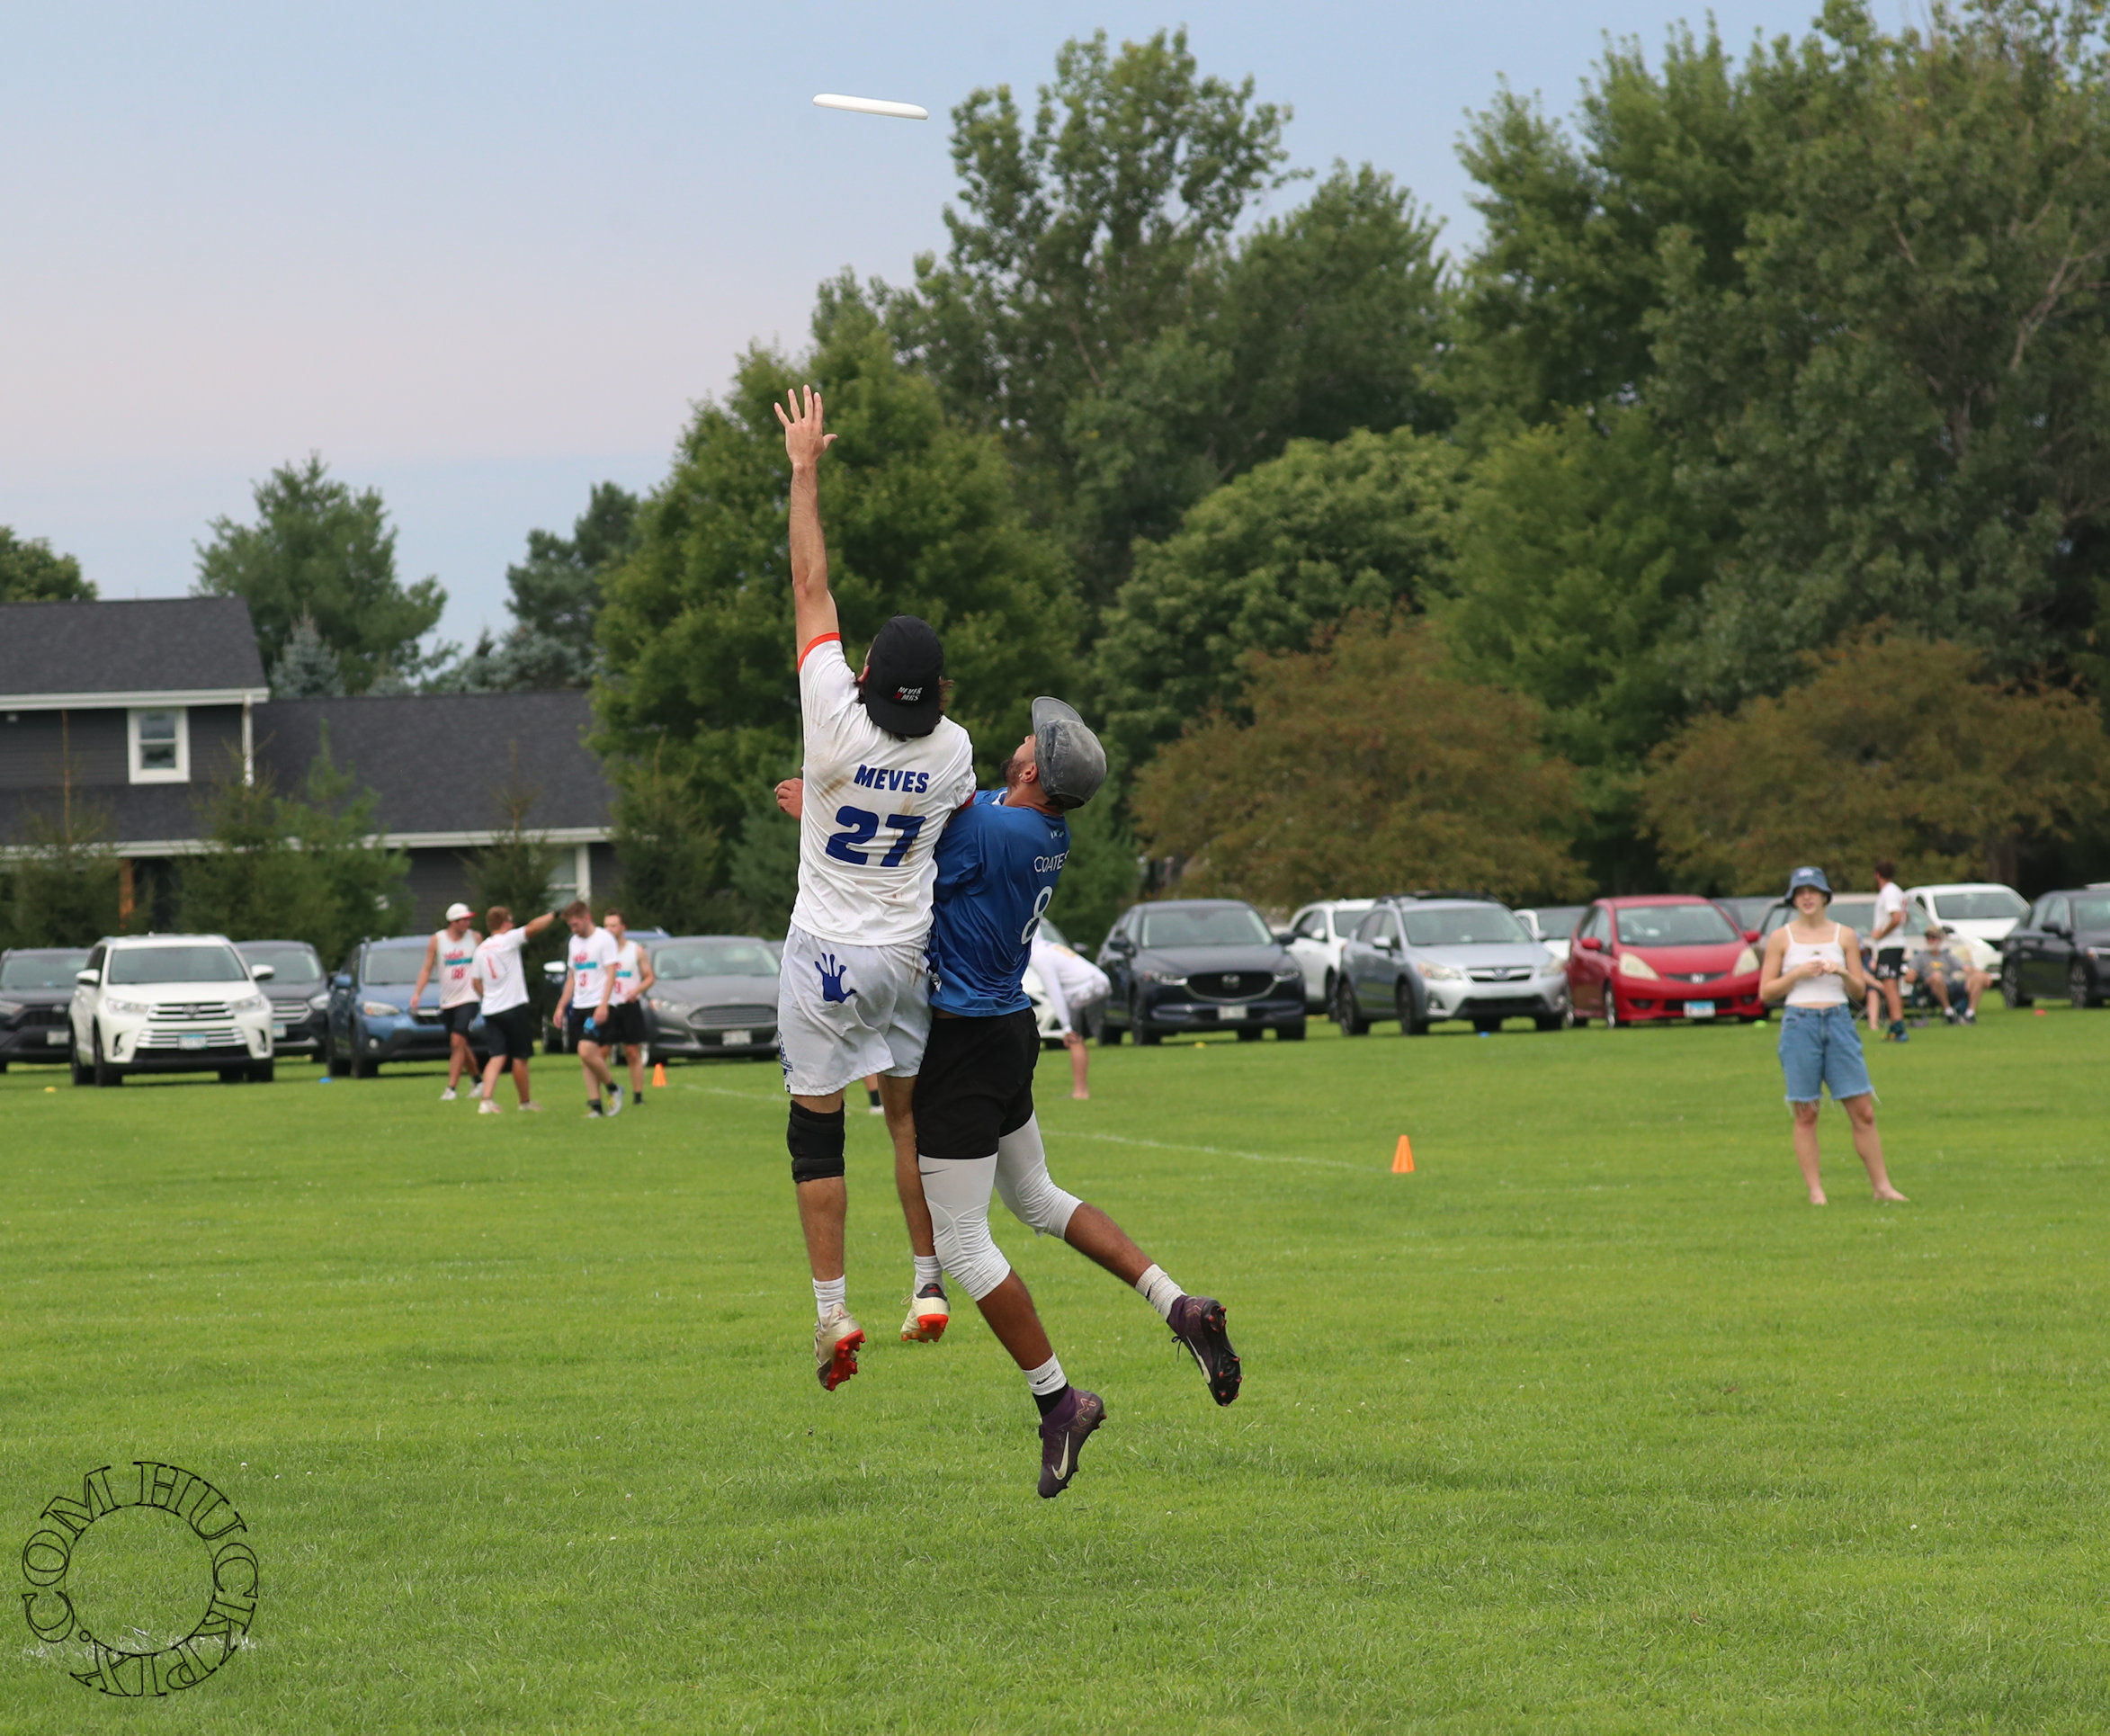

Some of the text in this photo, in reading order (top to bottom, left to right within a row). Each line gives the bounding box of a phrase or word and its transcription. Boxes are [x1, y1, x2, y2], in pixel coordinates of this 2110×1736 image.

[854, 764, 930, 793] MEVES
[826, 805, 926, 868] 27
[1021, 885, 1053, 945] 8
